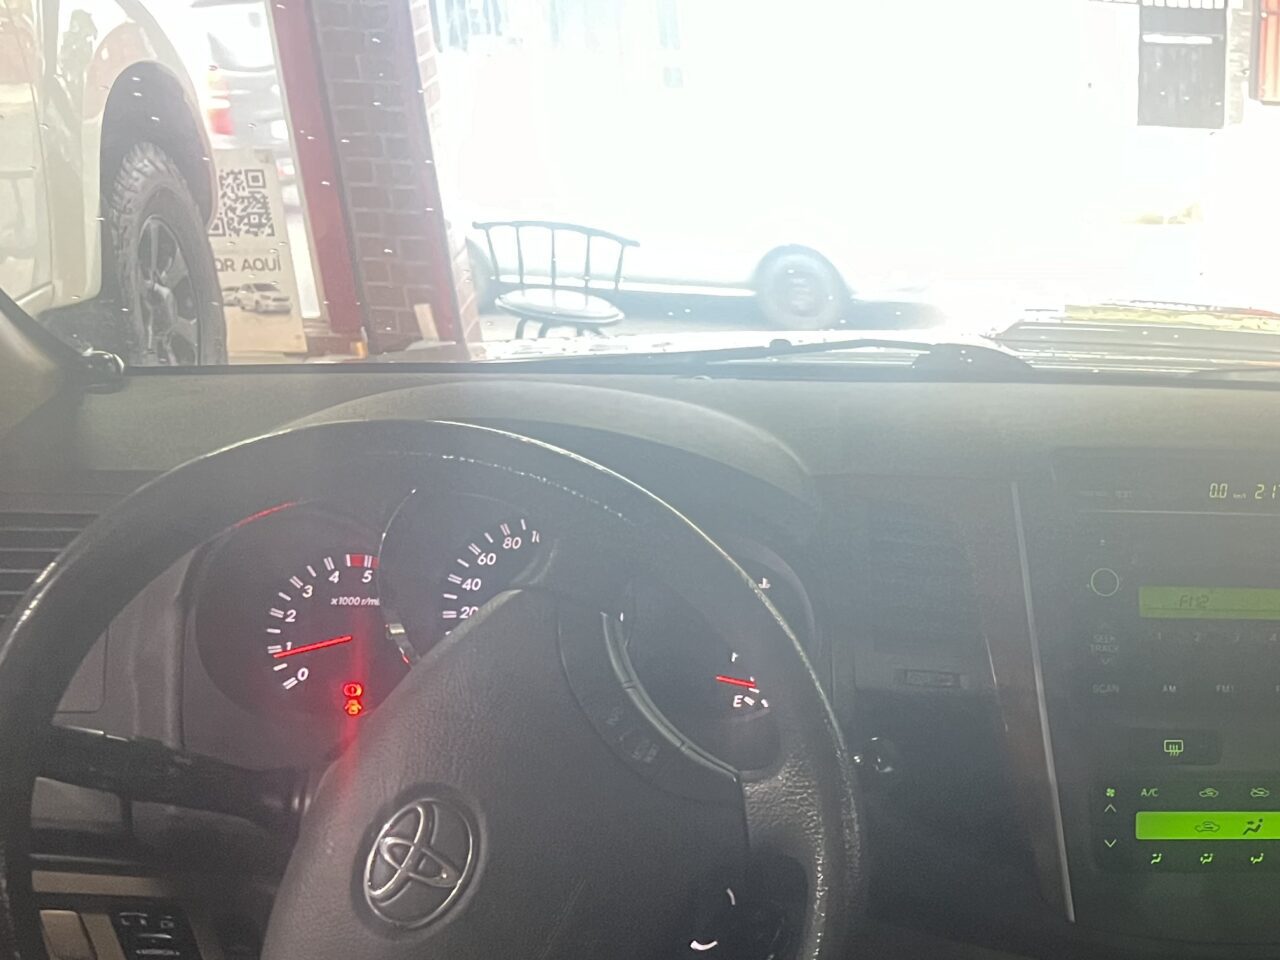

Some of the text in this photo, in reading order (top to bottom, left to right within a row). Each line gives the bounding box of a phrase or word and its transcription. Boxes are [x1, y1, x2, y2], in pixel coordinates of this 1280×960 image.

[241, 254, 282, 272] AQUÍ
[502, 536, 522, 550] 80
[477, 552, 497, 566] 60
[328, 570, 340, 584] 4
[361, 570, 373, 583] 5
[461, 577, 482, 591] 40
[302, 585, 314, 598] 3
[285, 609, 297, 622] 2
[297, 667, 309, 682] 0
[1162, 684, 1177, 693] AM
[733, 694, 745, 708] E
[1140, 788, 1159, 798] A/C
